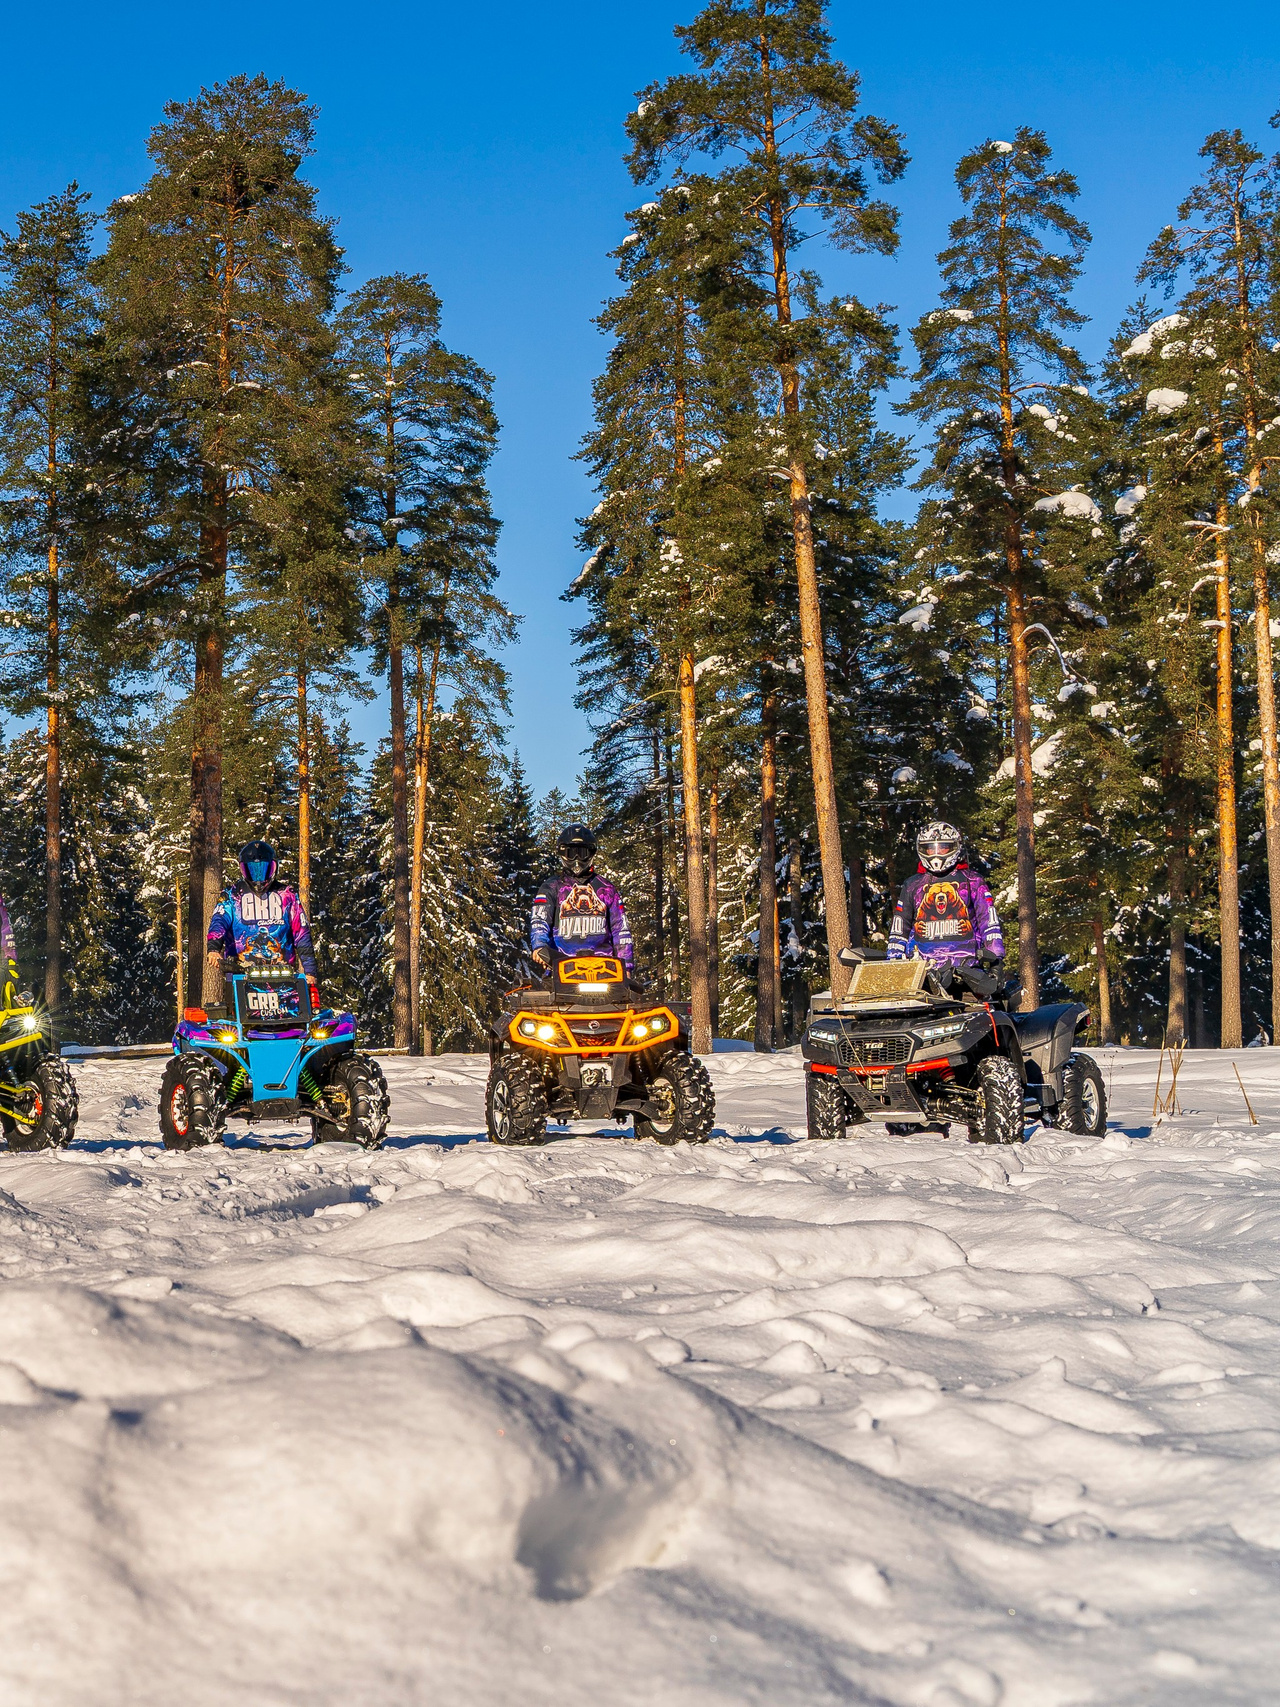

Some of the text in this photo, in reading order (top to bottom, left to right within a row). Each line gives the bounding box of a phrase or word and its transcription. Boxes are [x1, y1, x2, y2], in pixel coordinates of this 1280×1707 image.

[241, 892, 282, 920] GRB
[247, 992, 279, 1010] GRB
[260, 1007, 289, 1017] CUSTOM
